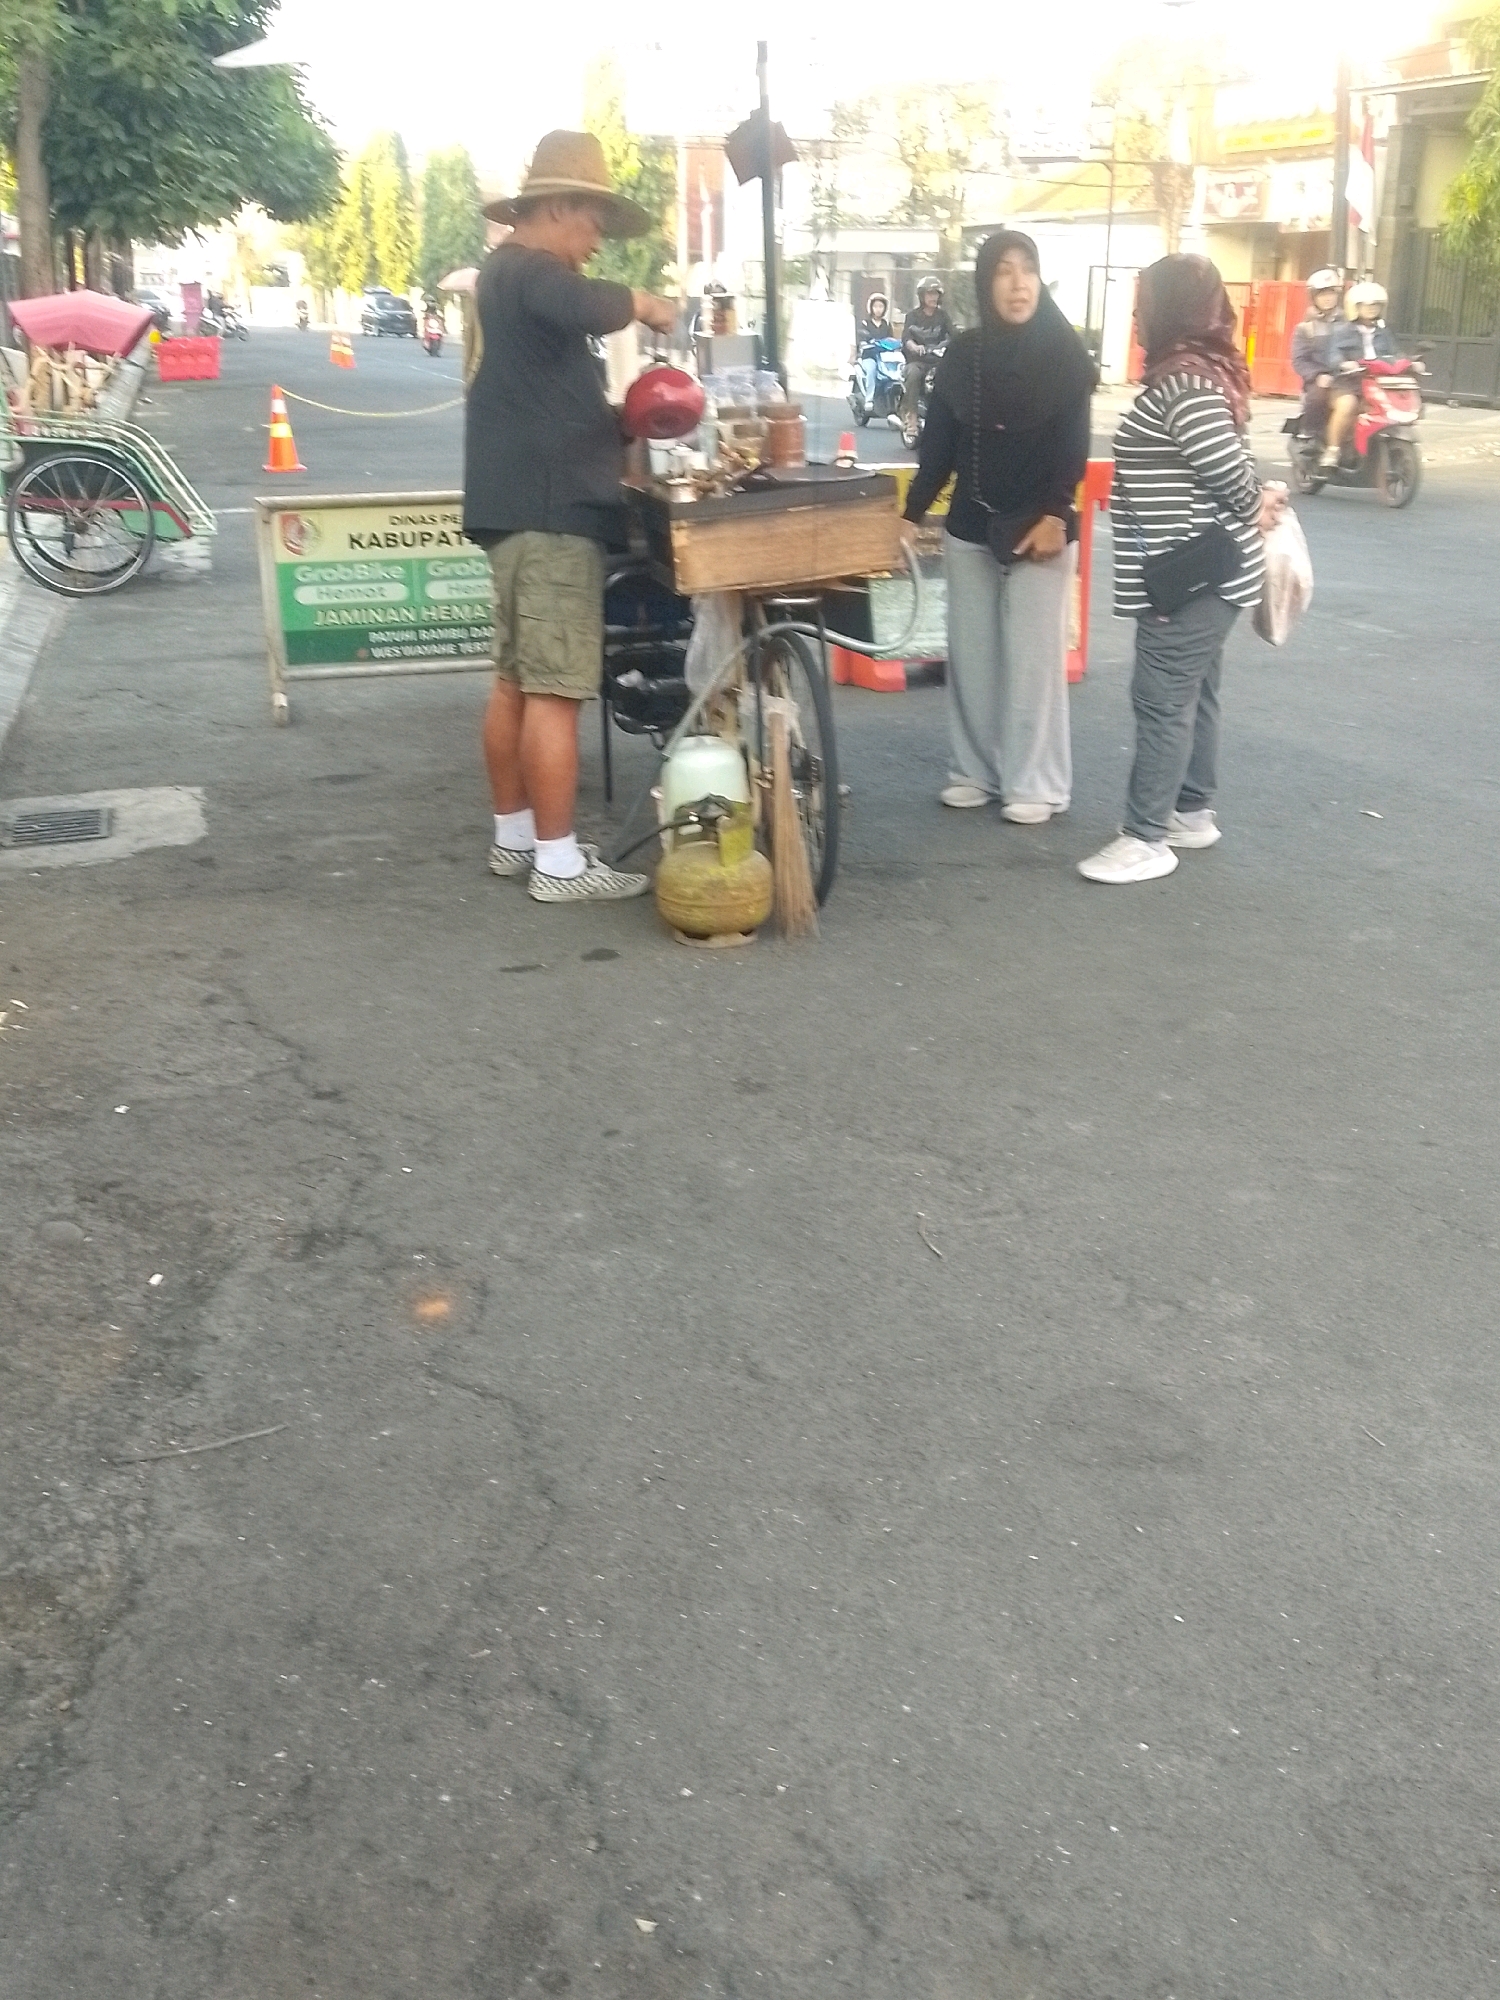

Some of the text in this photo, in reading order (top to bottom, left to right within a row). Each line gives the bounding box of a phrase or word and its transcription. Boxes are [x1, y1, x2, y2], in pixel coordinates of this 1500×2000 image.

[389, 514, 438, 526] DINAS
[295, 562, 405, 583] GrabBike
[314, 606, 417, 626] JAMINAN
